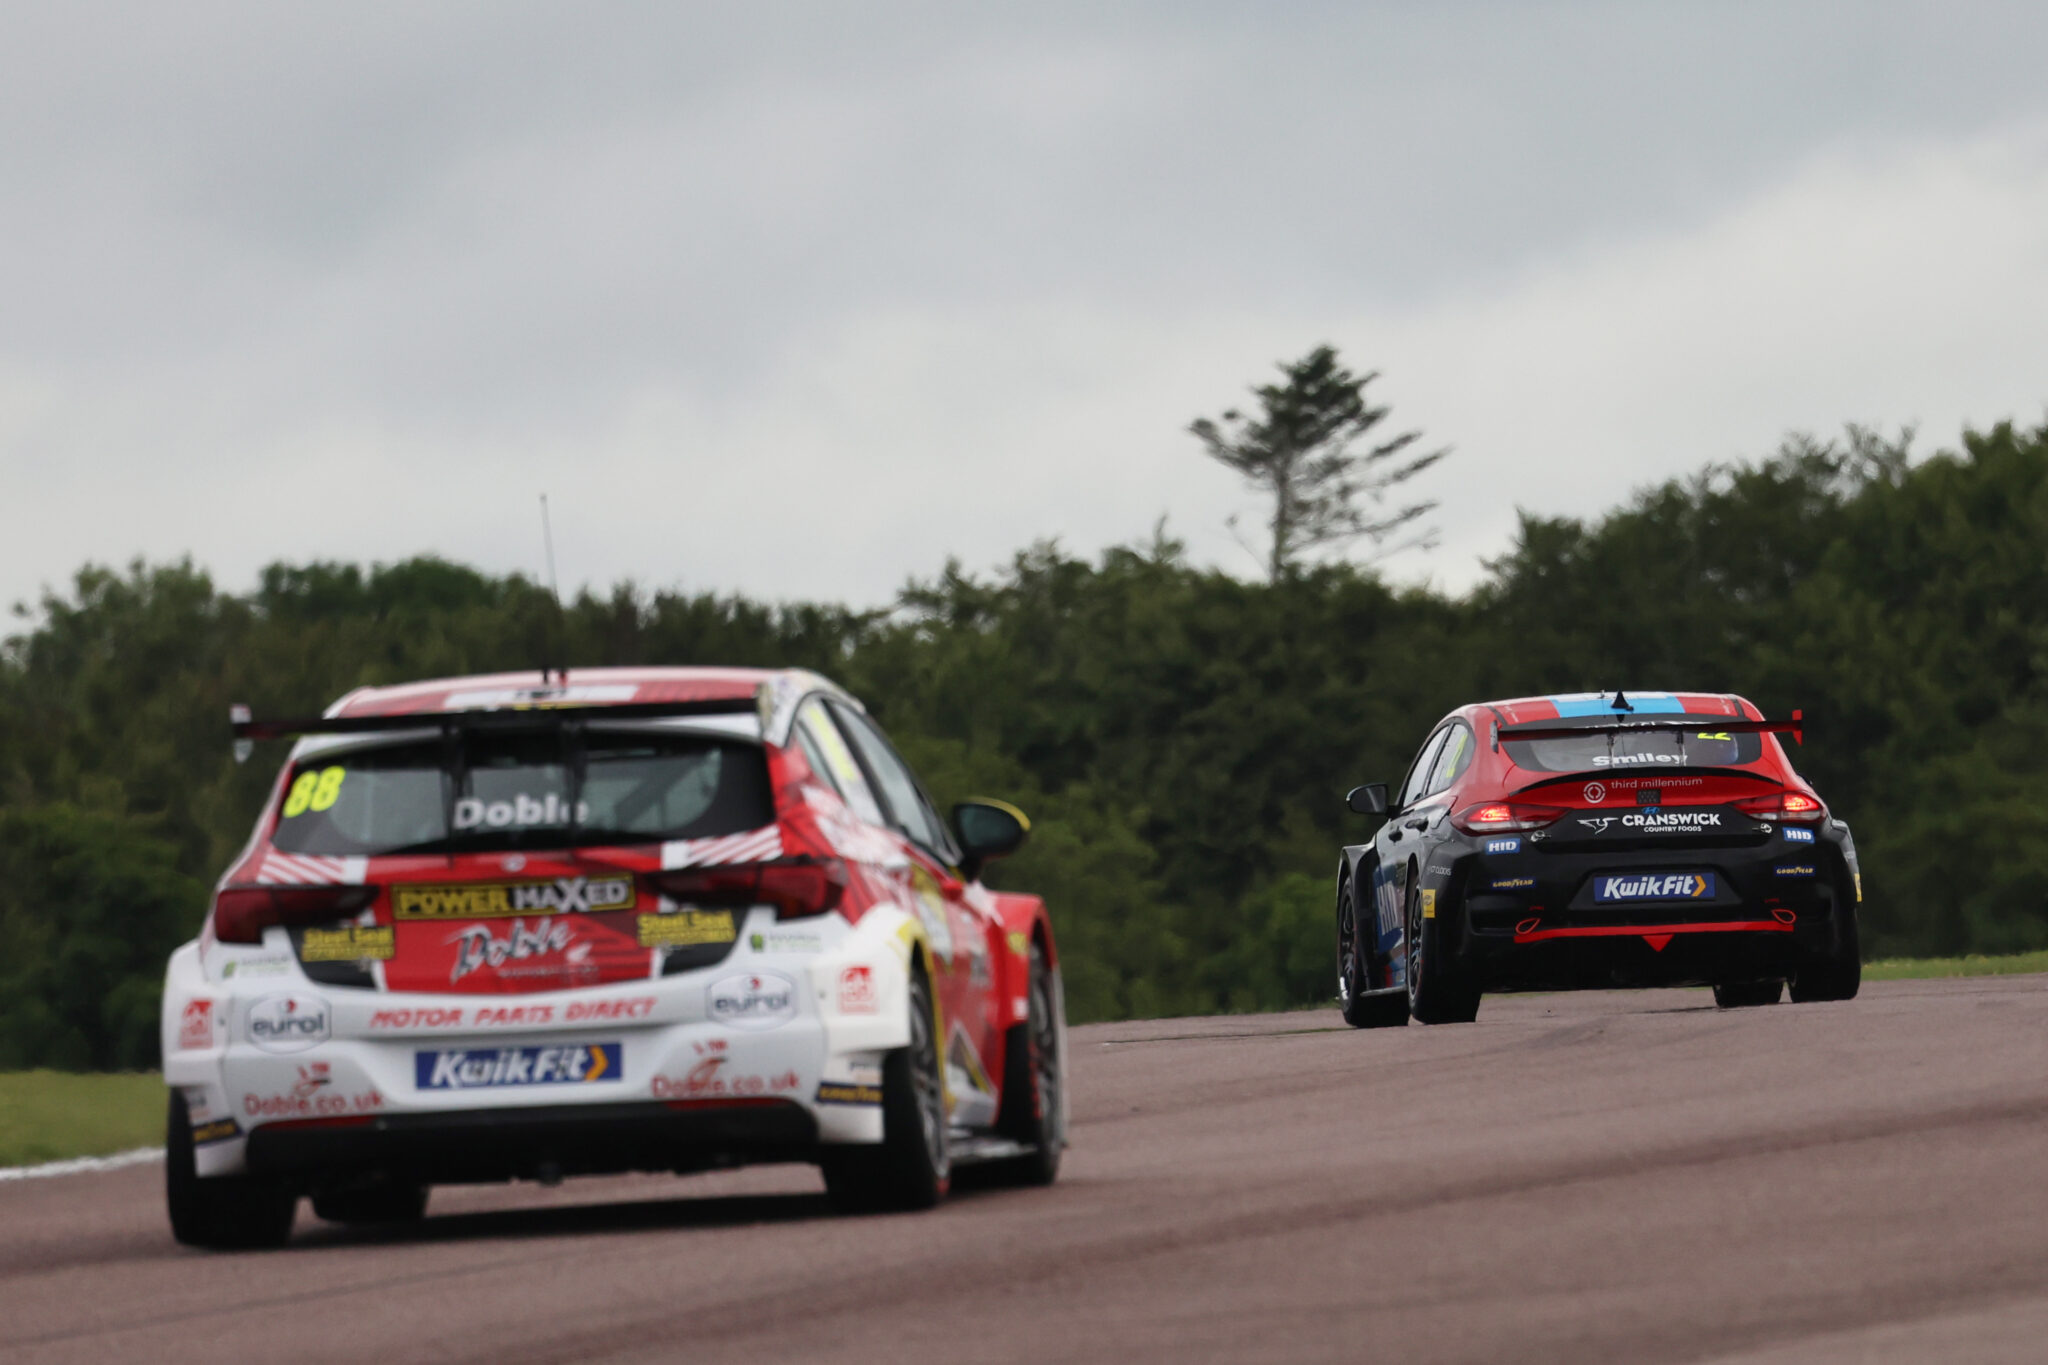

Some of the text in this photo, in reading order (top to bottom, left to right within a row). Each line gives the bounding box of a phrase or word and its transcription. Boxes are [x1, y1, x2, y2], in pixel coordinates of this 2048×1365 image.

[1592, 753, 1688, 766] Smiley
[284, 766, 346, 818] 88
[1611, 777, 1703, 789] third millennium
[454, 795, 589, 828] Doble
[1622, 813, 1721, 827] CRANSWICK
[1643, 825, 1677, 833] COUNTRY
[1785, 829, 1812, 840] HID
[1488, 841, 1517, 852] HID
[1776, 866, 1814, 875] GOODYEAR
[1492, 878, 1534, 888] GOODYEAR
[400, 889, 511, 914] POWER
[441, 915, 577, 986] Doble
[369, 998, 658, 1028] MOTOR PARTS DIRECT
[715, 991, 789, 1013] eurol
[252, 1012, 326, 1037] eurol
[652, 1069, 801, 1098] Doble.co.uk
[243, 1090, 384, 1116] Doble.co.uk
